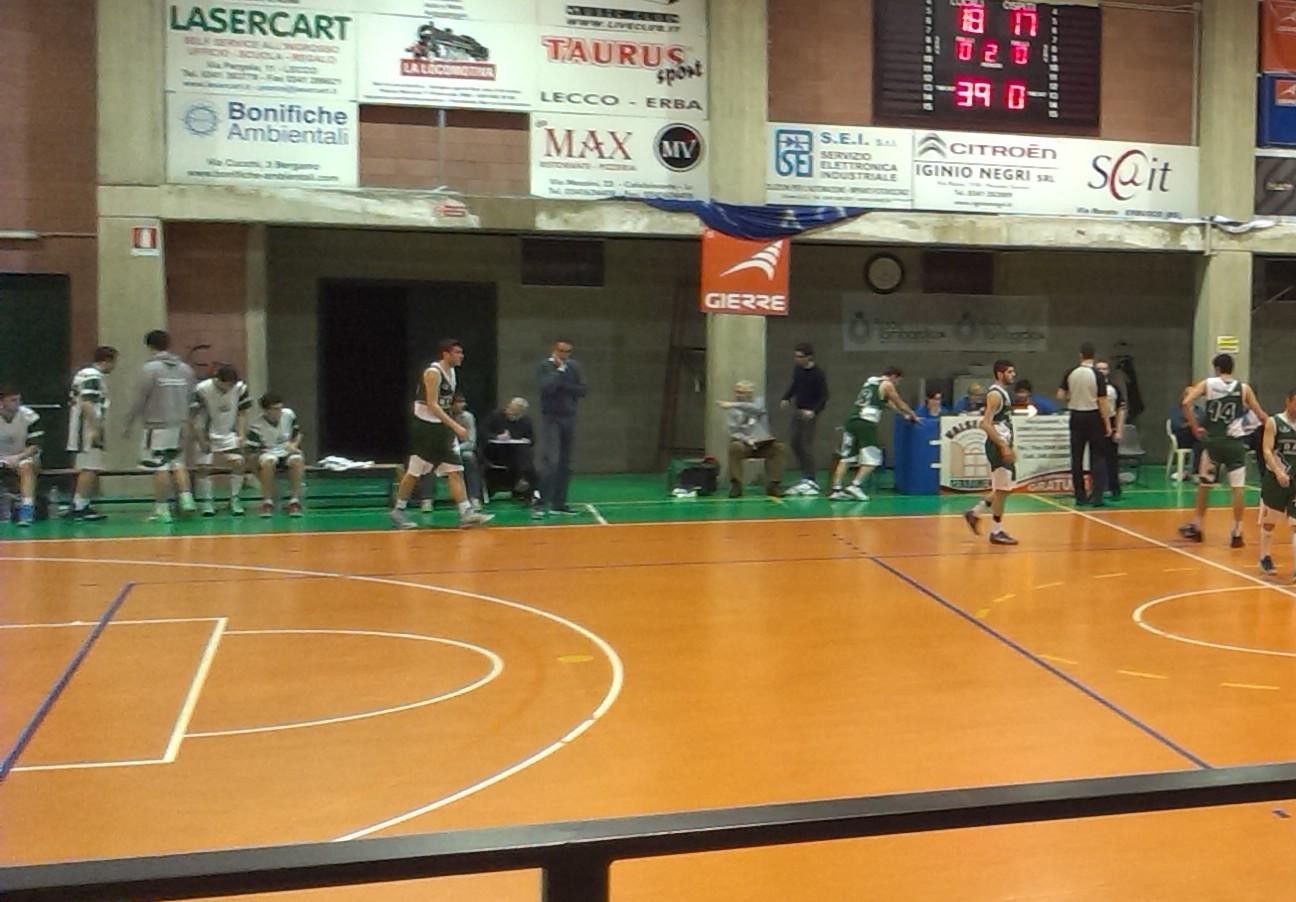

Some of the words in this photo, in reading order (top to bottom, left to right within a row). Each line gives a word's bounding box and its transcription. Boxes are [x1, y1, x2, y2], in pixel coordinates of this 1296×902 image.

[169, 5, 353, 41] LASERCART
[1015, 12, 1037, 37] 17
[542, 35, 687, 69] TAURUS
[984, 44, 998, 62] 2
[656, 60, 703, 87] sport
[541, 91, 619, 106] LECCO
[646, 97, 703, 111] ERBA
[957, 81, 992, 107] 39
[1008, 85, 1025, 109] 0
[228, 101, 348, 125] Bonifiche
[227, 123, 349, 145] Ambientali
[544, 128, 633, 160] MAX
[820, 132, 870, 145] S.E.I.
[662, 139, 697, 159] MV
[820, 151, 872, 161] SERVIZIO
[820, 161, 898, 172] ELETTRONICA
[820, 171, 897, 182] INDUSTRIALE
[916, 164, 973, 178] IGINIO
[979, 167, 1031, 181] NEGRI
[705, 293, 786, 311] GIERRE
